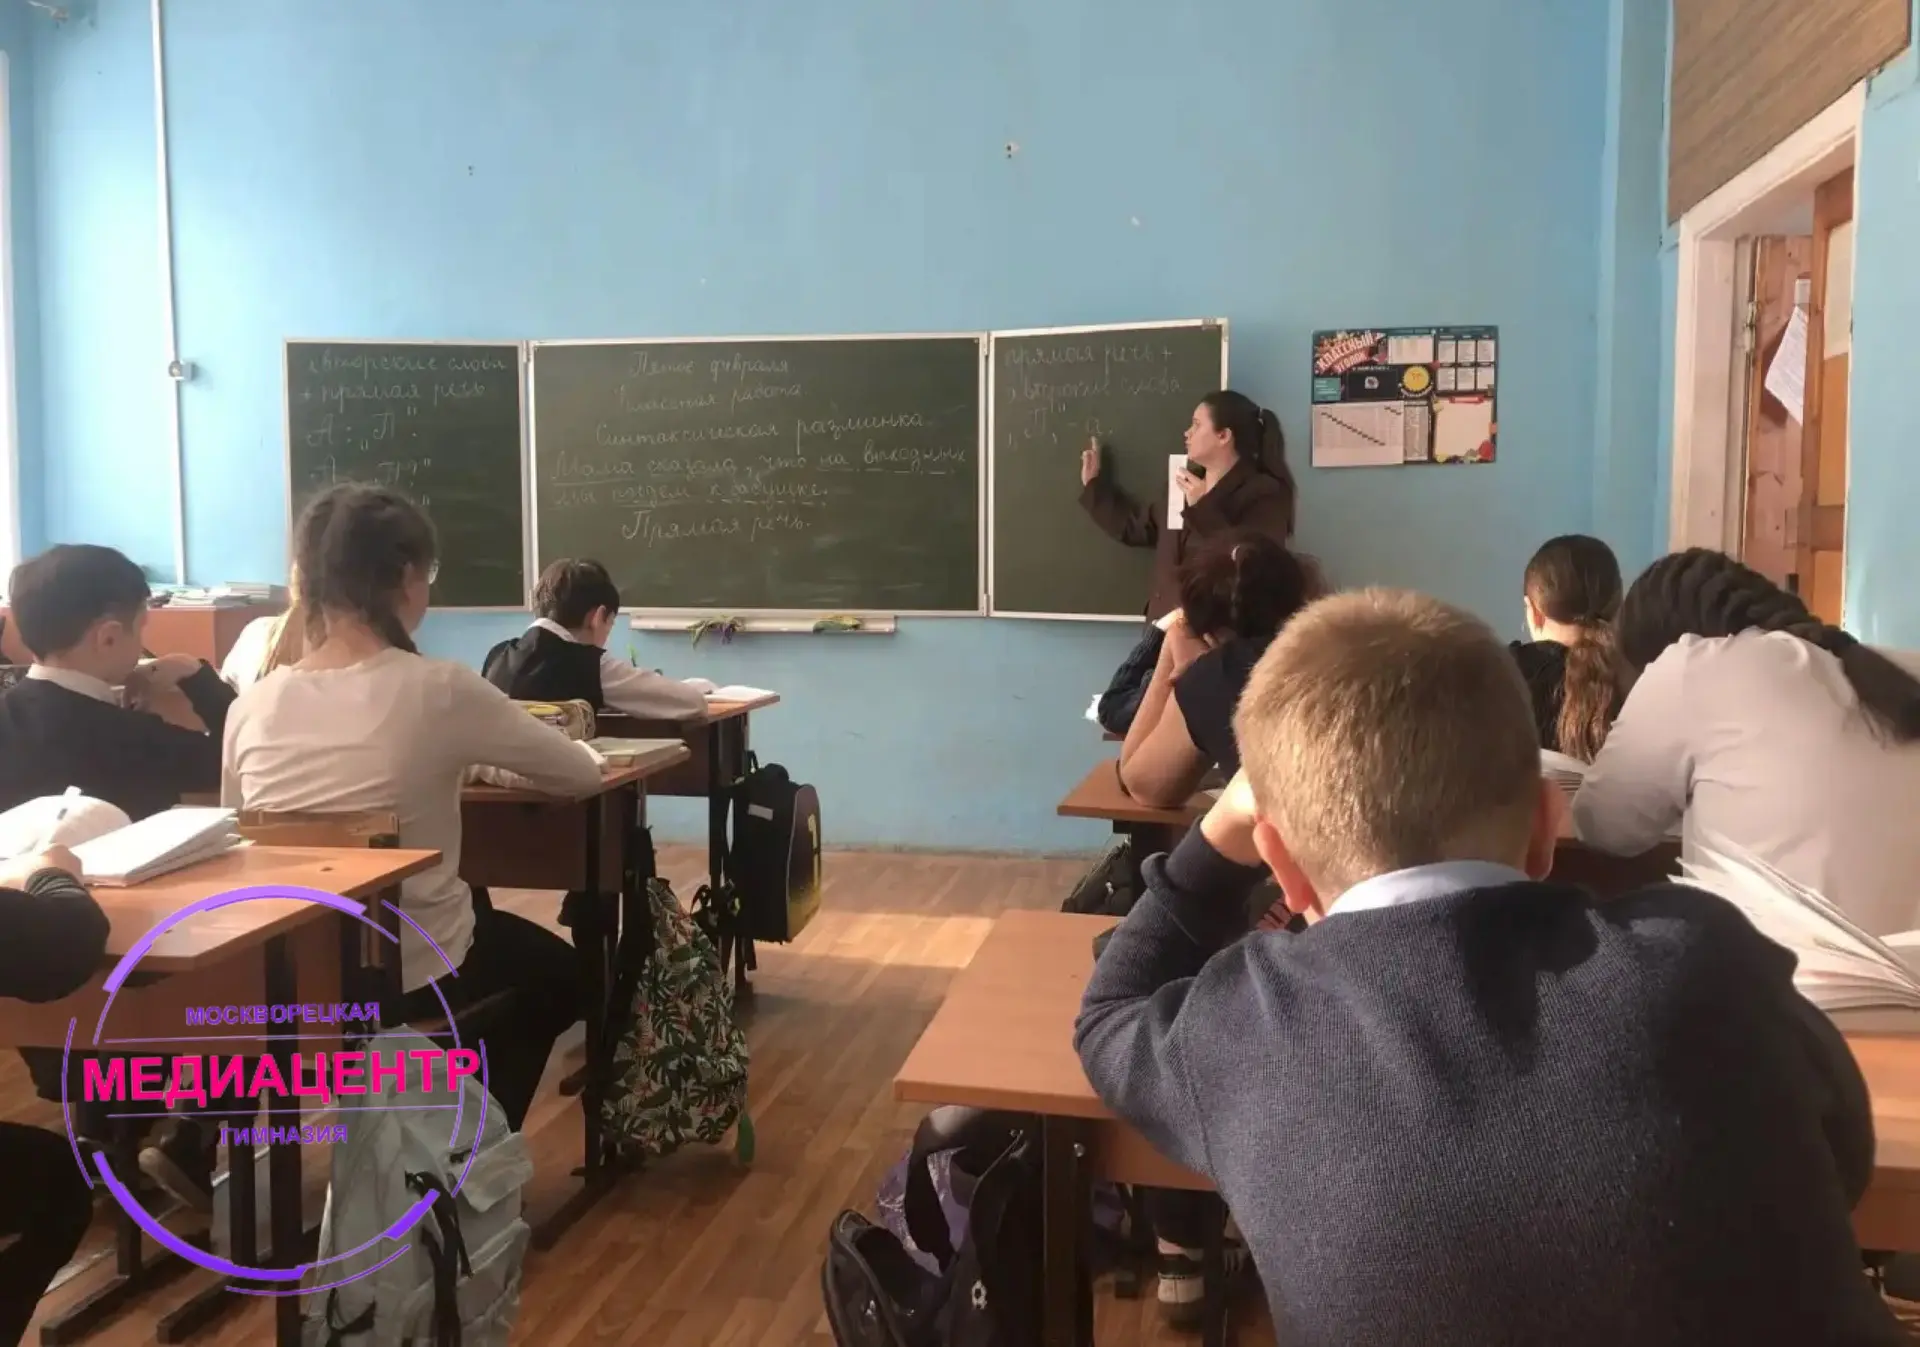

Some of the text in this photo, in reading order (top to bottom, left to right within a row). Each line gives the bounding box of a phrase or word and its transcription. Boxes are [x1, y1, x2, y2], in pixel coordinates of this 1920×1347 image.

[321, 383, 421, 414] прямая
[552, 450, 635, 480] Мама
[819, 453, 849, 466] на
[621, 509, 741, 548] Прямая
